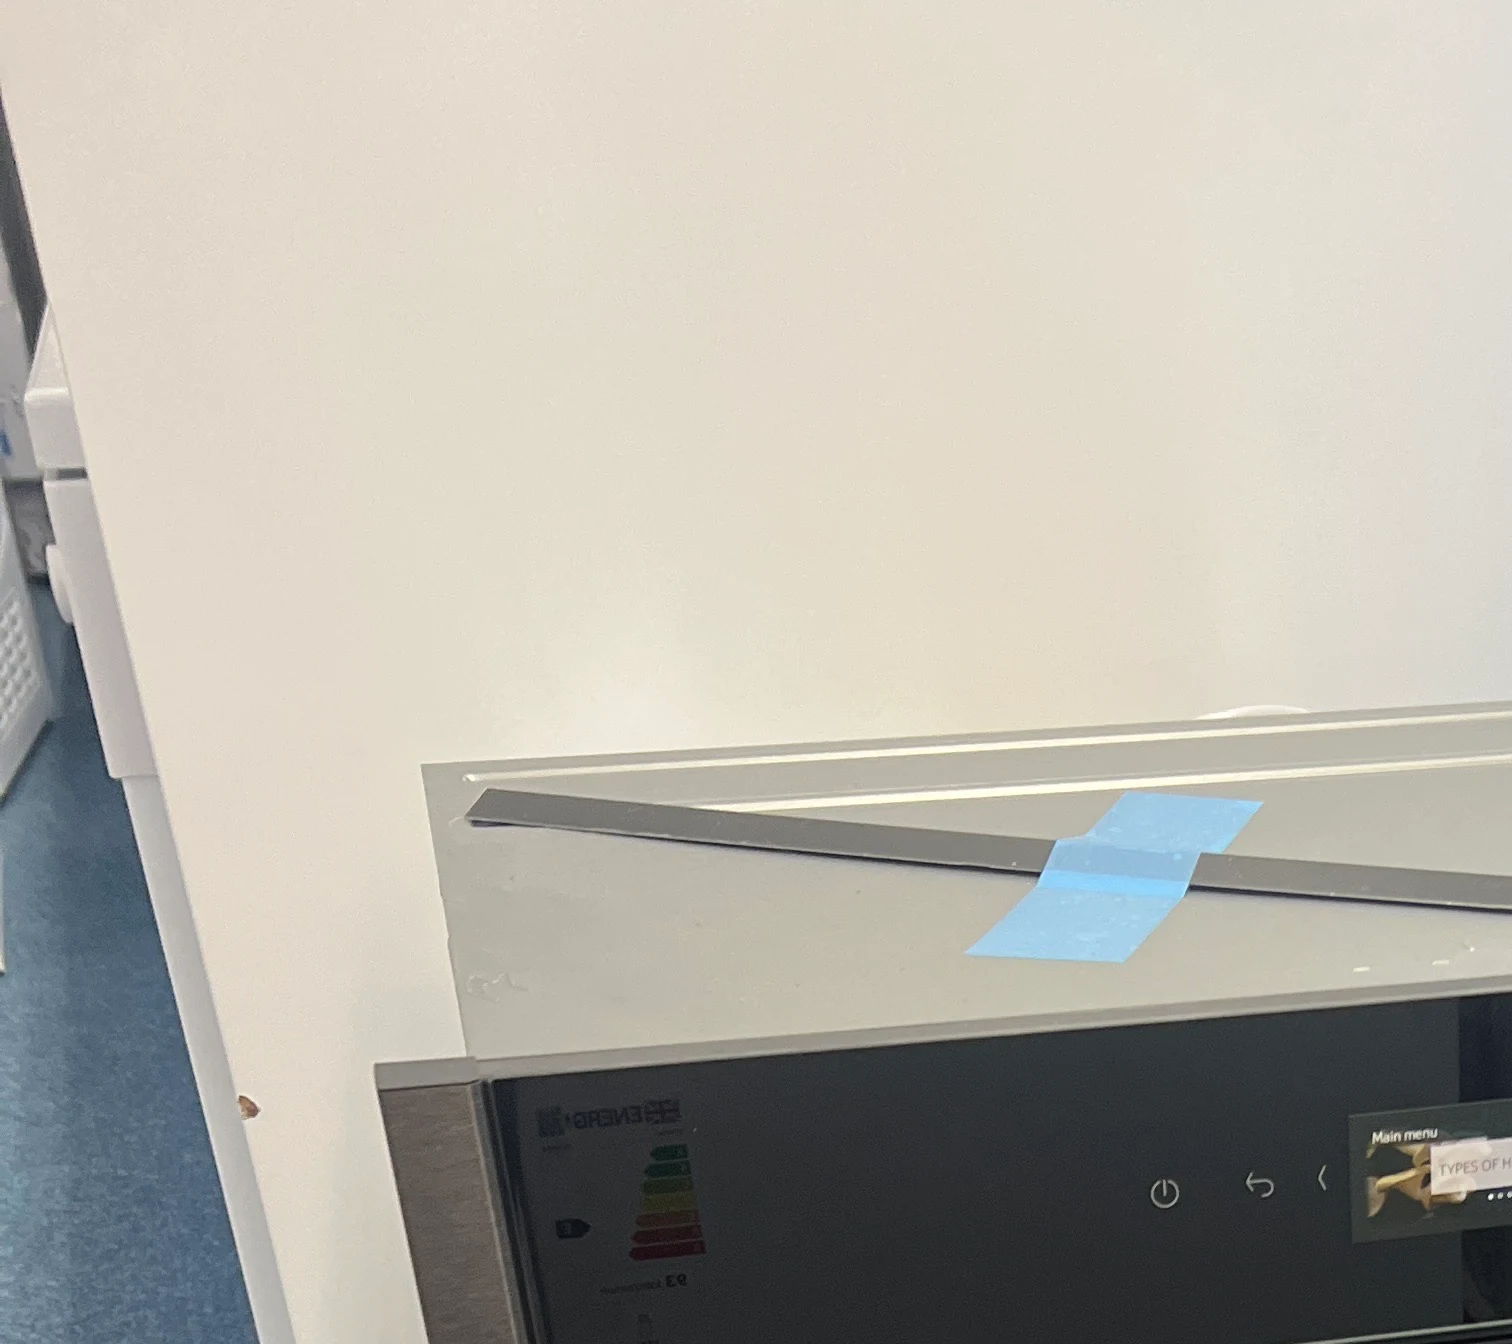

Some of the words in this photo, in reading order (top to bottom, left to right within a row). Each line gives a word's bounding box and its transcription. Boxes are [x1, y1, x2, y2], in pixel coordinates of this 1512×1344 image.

[1371, 1129, 1401, 1144] Main
[1404, 1127, 1438, 1141] menu
[1439, 1160, 1479, 1177] TYPES
[1481, 1157, 1499, 1172] OF
